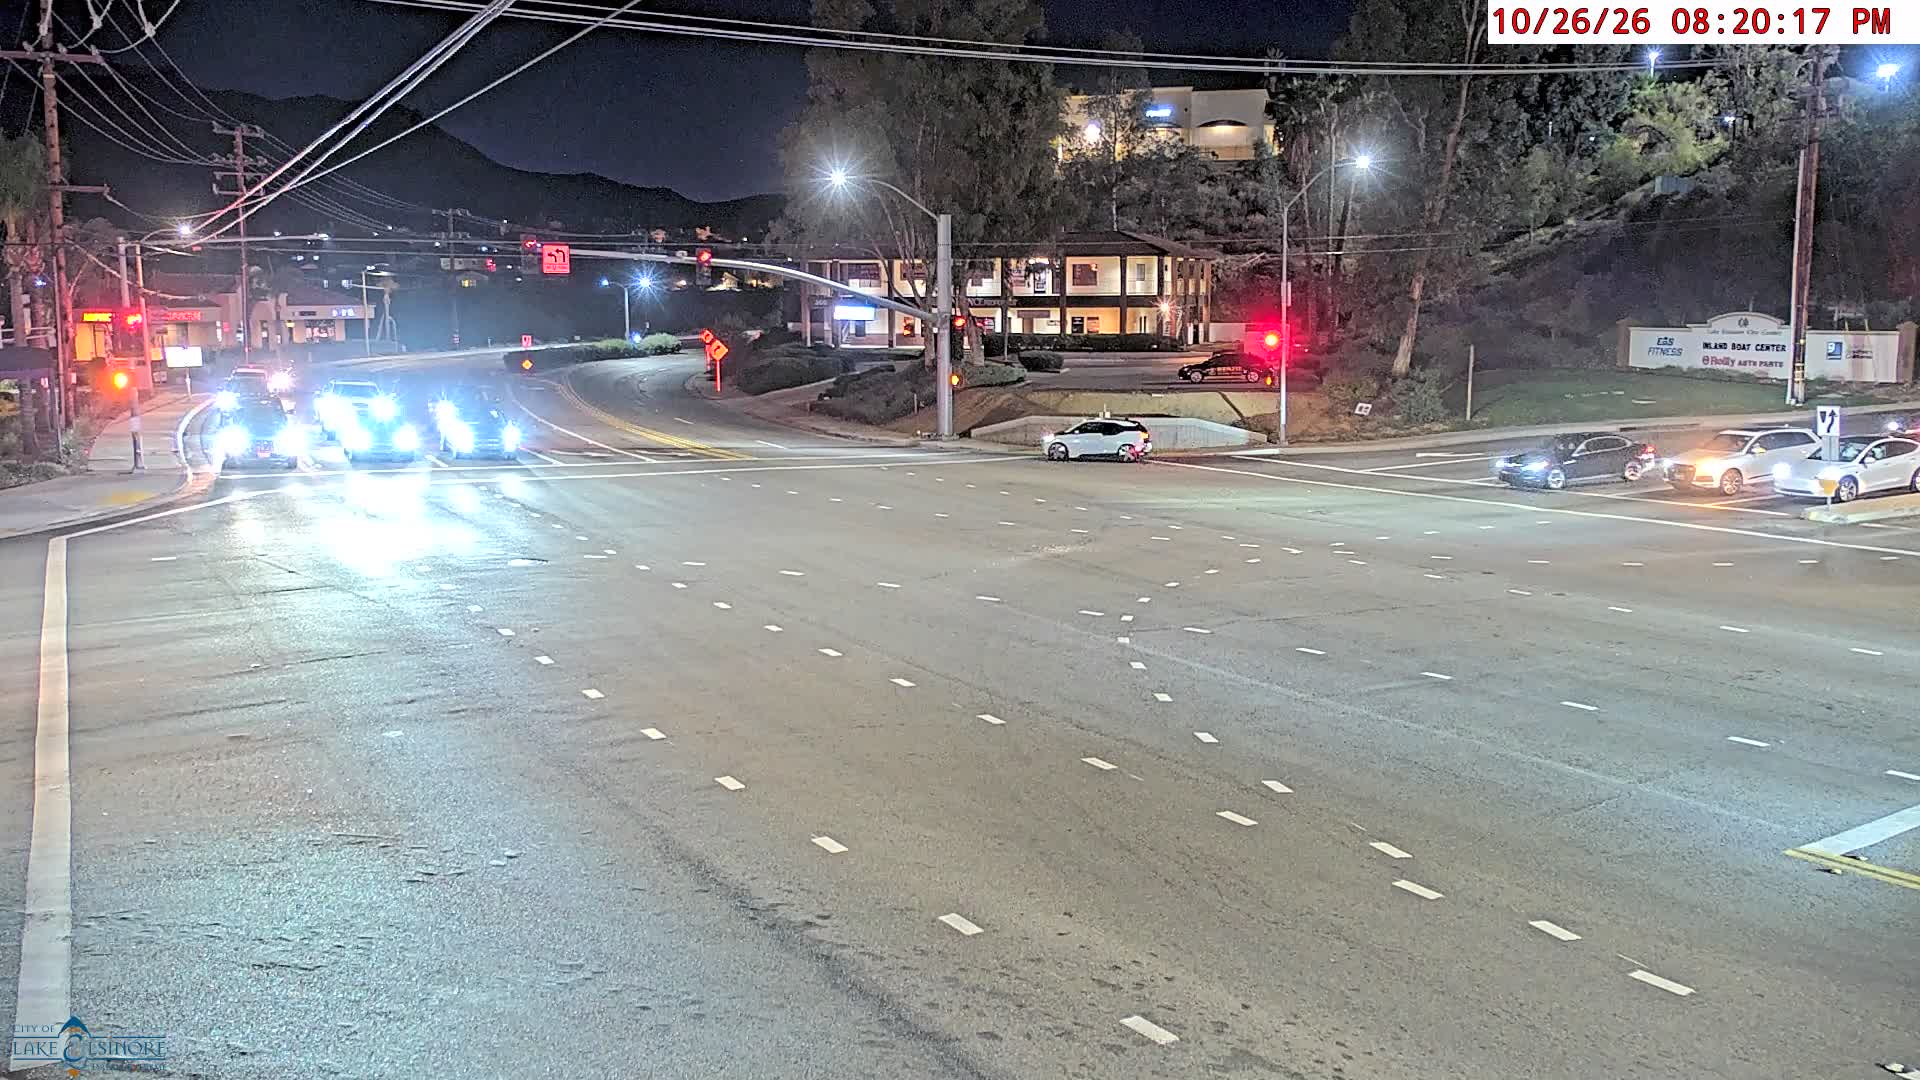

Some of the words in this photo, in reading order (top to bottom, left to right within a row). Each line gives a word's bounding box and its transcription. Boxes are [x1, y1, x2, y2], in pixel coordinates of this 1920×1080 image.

[1647, 346, 1683, 356] FITNESS
[1731, 342, 1751, 351] BOAT
[1755, 343, 1786, 352] CENTER
